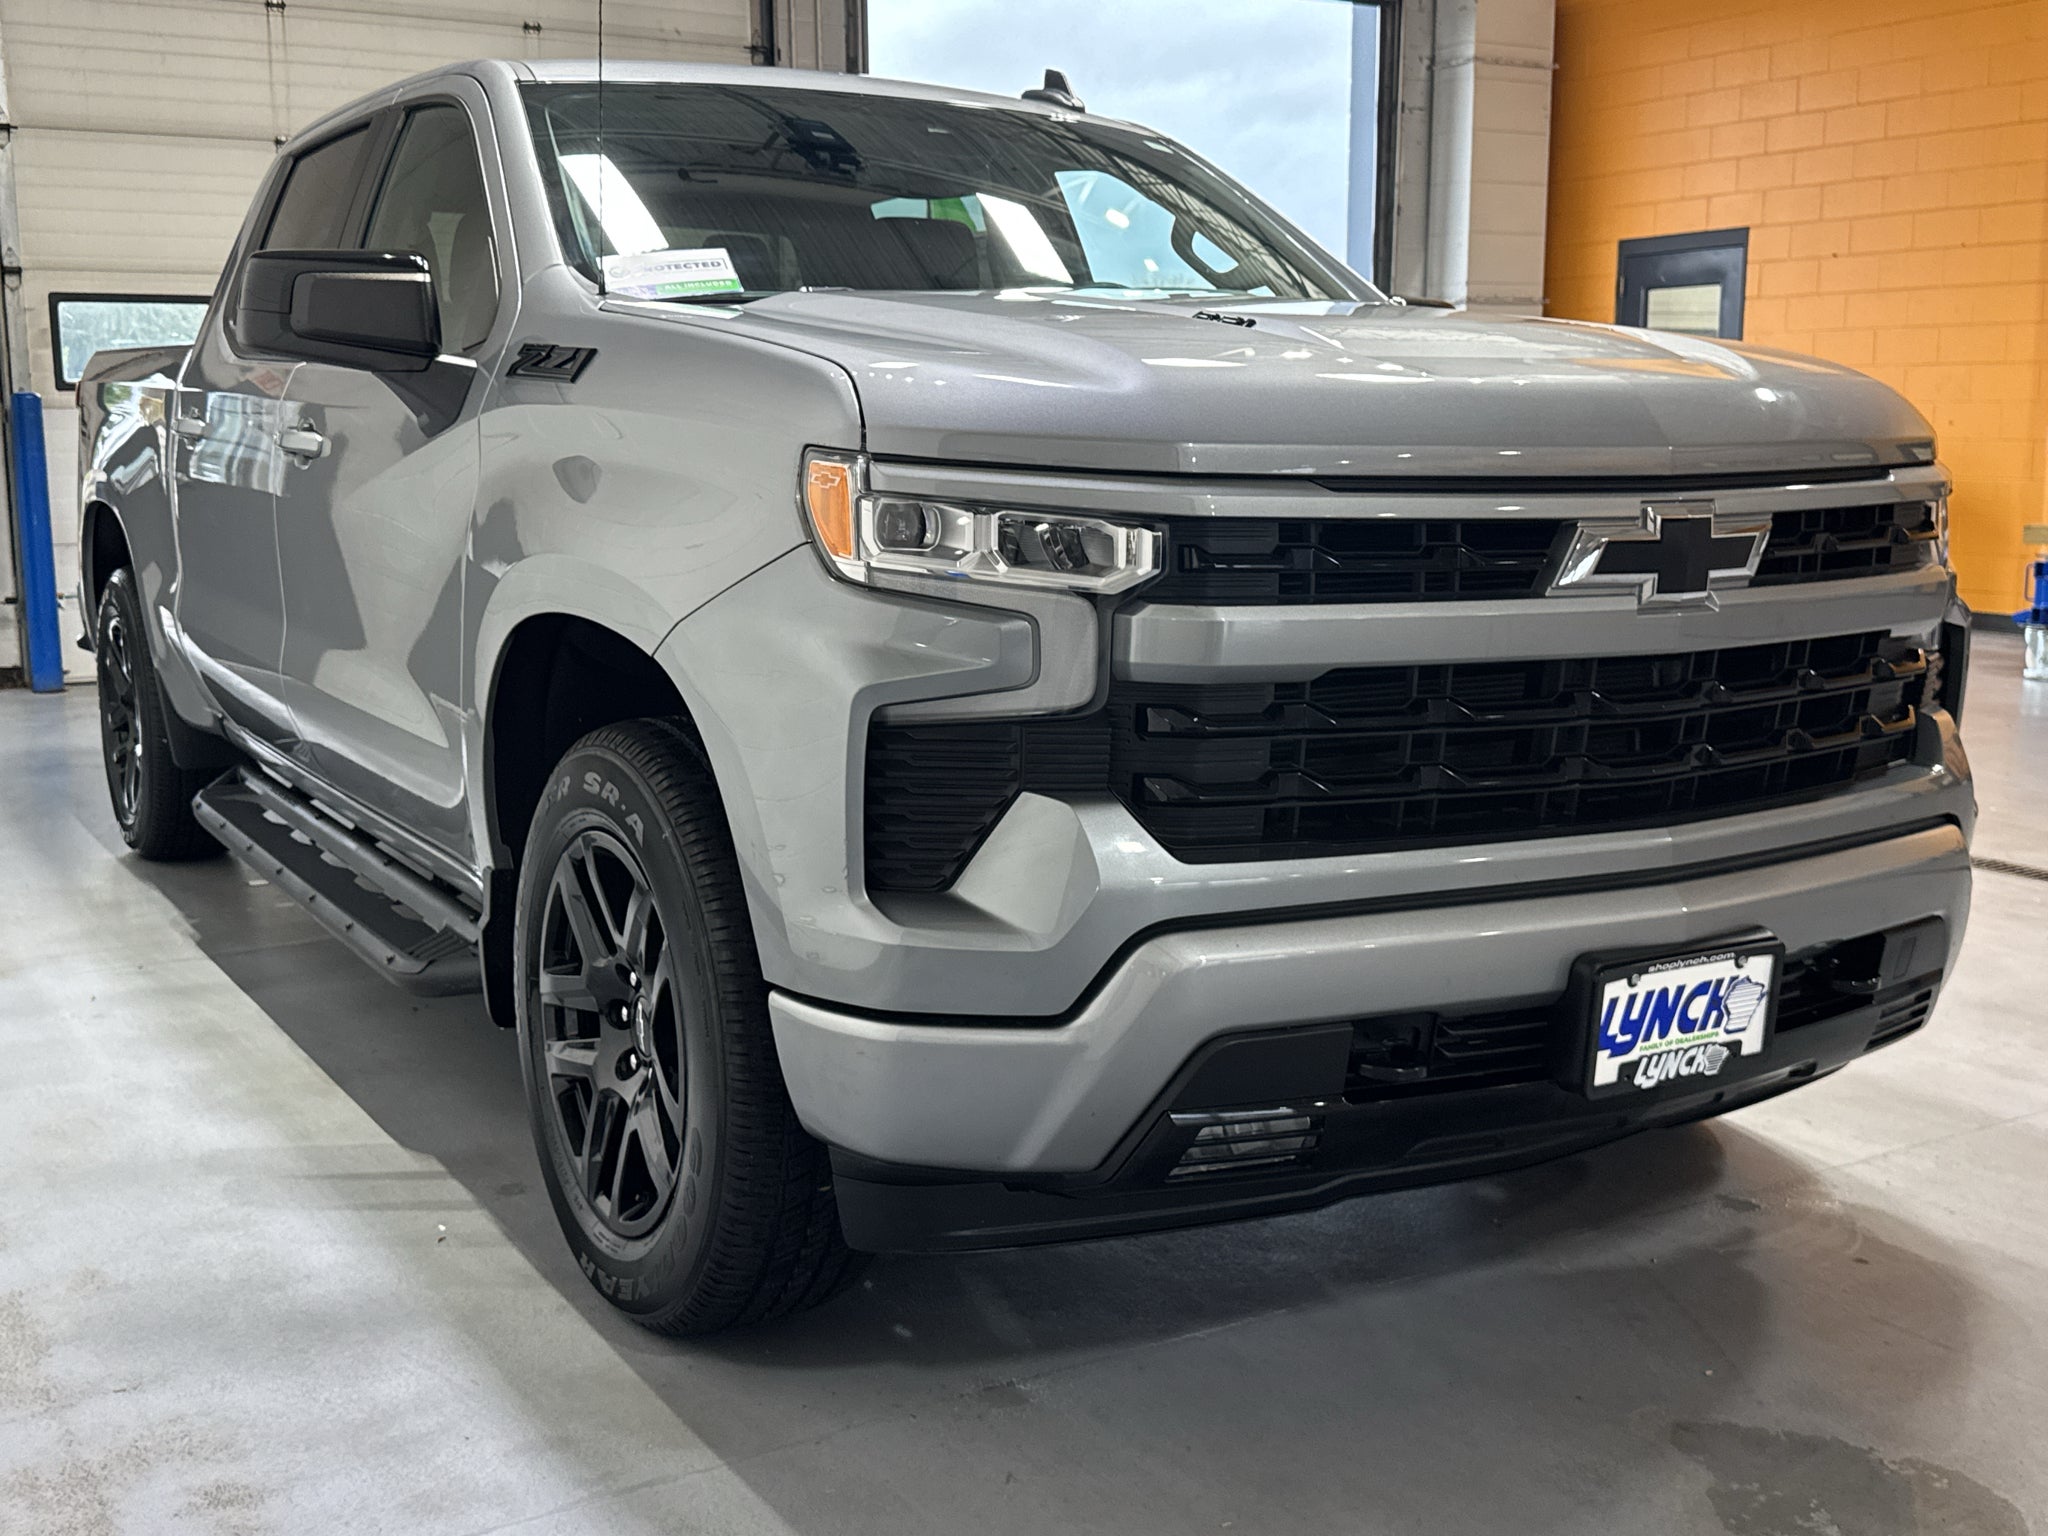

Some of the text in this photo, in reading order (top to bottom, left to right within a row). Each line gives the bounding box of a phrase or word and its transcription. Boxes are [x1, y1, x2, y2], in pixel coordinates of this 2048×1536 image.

[1647, 952, 1735, 973] shoplynch.com
[1599, 975, 1739, 1058] LYNCH
[1640, 1042, 1663, 1052] FAMILY
[1664, 1040, 1674, 1048] OF
[1633, 1045, 1705, 1089] LYNCH
